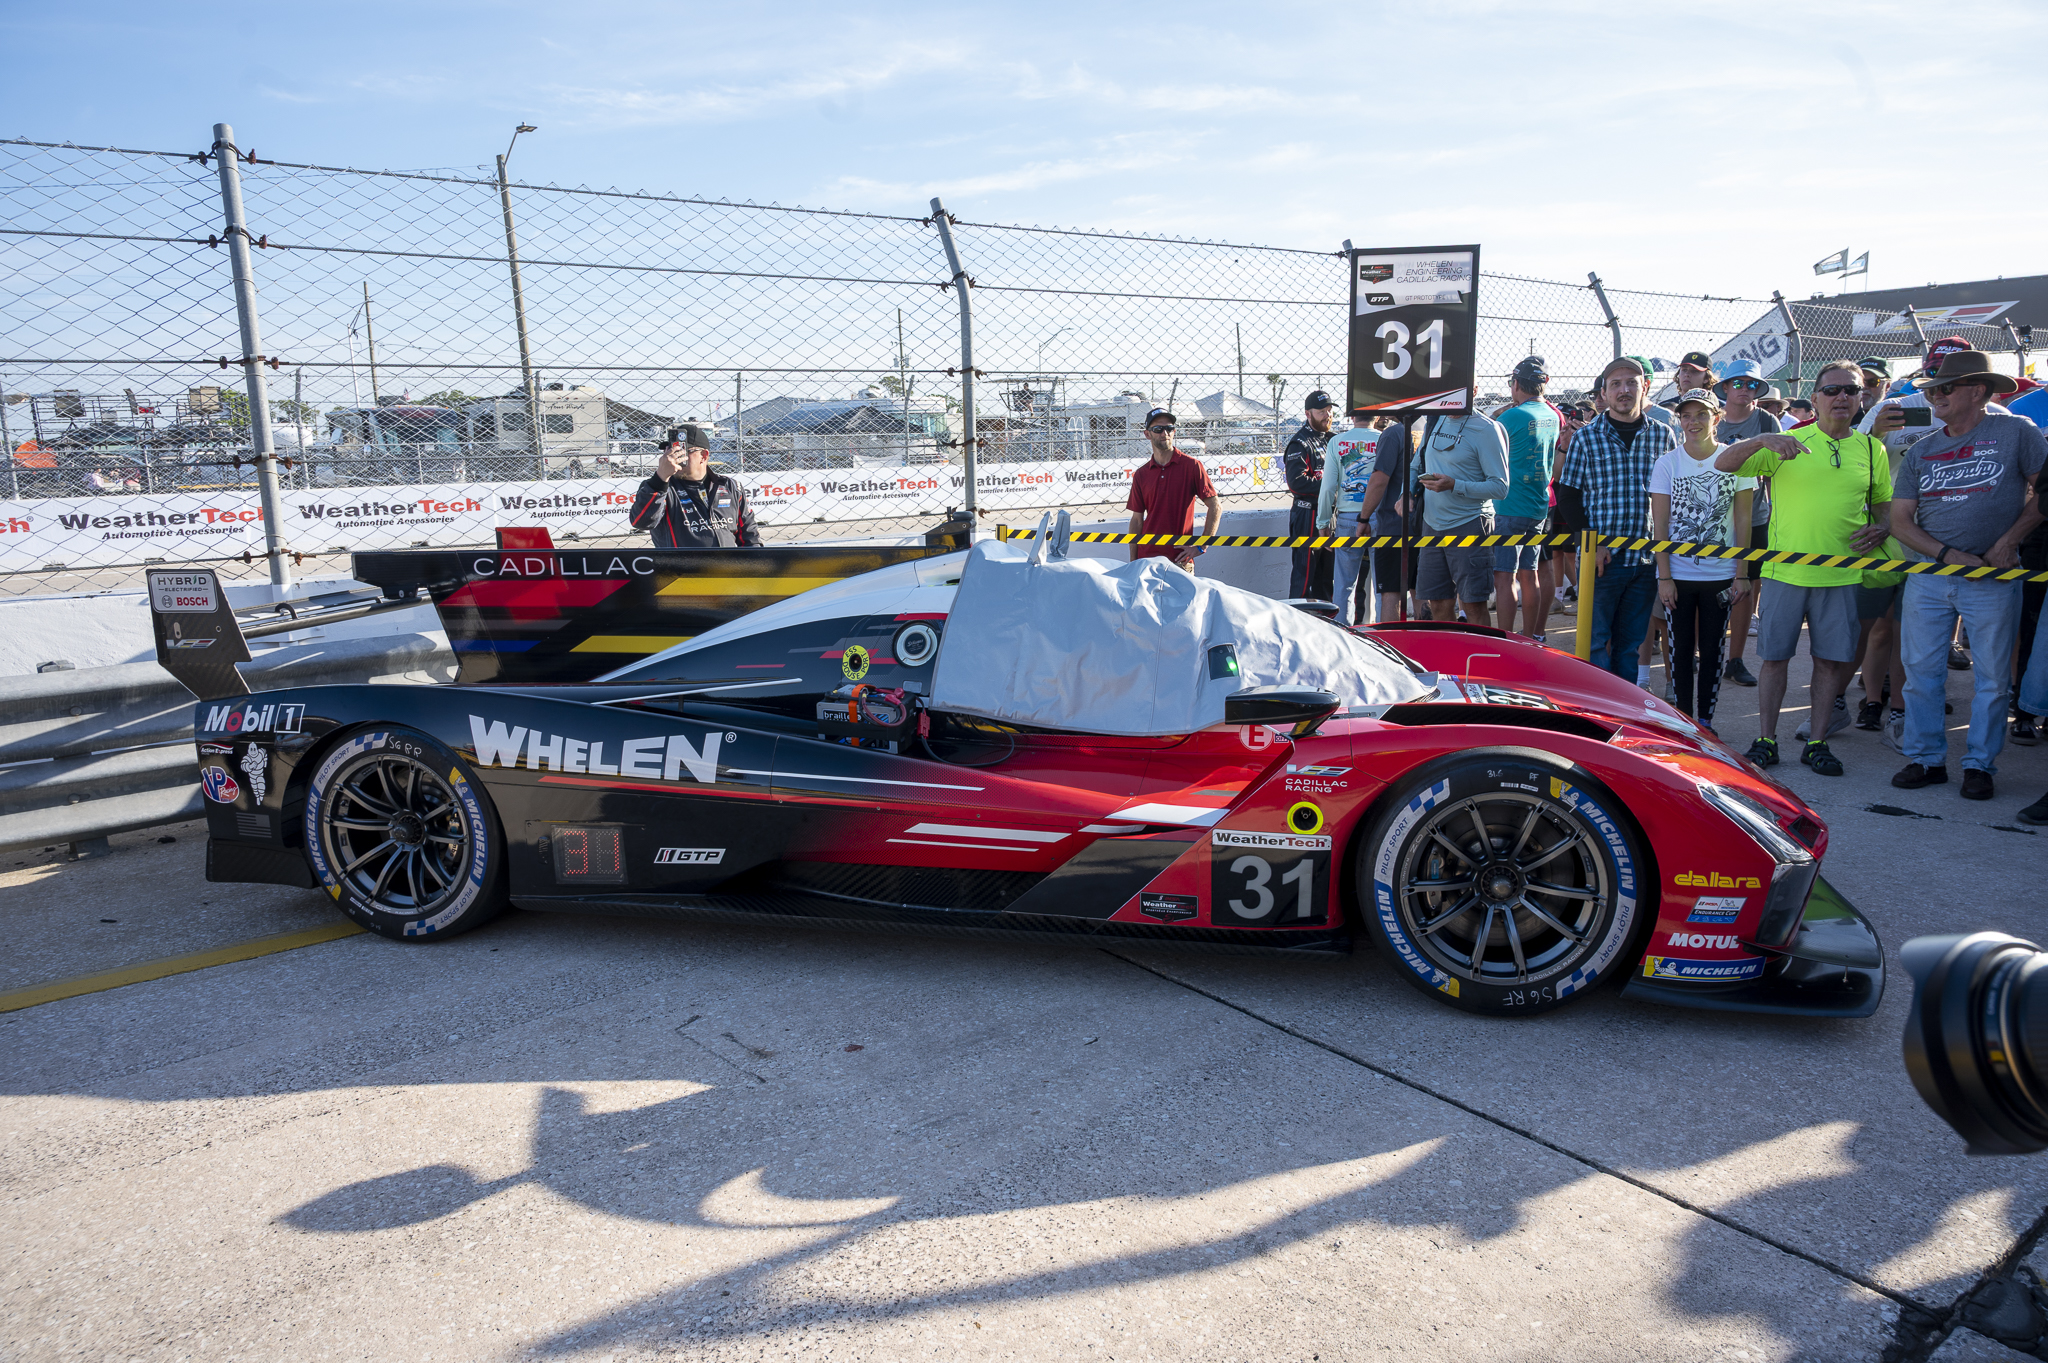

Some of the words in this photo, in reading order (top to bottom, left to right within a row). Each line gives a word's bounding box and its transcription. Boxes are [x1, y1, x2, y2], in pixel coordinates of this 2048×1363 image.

[1406, 267, 1463, 276] ENGINEERING
[1416, 260, 1454, 268] WHELEN
[1396, 275, 1438, 284] CADILLAC
[1440, 274, 1472, 282] RACING
[1372, 319, 1444, 380] 31
[1206, 465, 1247, 475] erTech
[951, 473, 1053, 487] WatherTech
[744, 483, 807, 497] erTech
[1956, 486, 1993, 494] SUPPLY
[500, 492, 636, 510] WeatherTec
[335, 519, 394, 528] Automotive
[397, 516, 455, 525] Accessories
[530, 510, 581, 518] Automotive
[102, 528, 173, 541] Automotive
[176, 525, 245, 536] Accessories
[473, 556, 655, 577] CADILLAC
[157, 575, 207, 585] HYBRID
[176, 597, 209, 606] BOSCH
[844, 646, 858, 658] ESS
[842, 661, 860, 680] DOUSE
[860, 652, 869, 674] PORT
[204, 705, 275, 732] Mobil
[285, 707, 295, 730] 1
[1248, 725, 1265, 747] E
[318, 764, 331, 784] PILOT
[331, 747, 350, 766] SPORT
[201, 766, 227, 802] VP
[1285, 778, 1348, 787] CADILLAC
[1285, 785, 1332, 793] RACING
[307, 792, 326, 871] MICHELIN
[465, 798, 485, 879] MICHELIN
[1216, 832, 1326, 848] WeatherTech
[1381, 849, 1392, 875] PILOT
[1389, 817, 1408, 847] SPORT
[1580, 801, 1634, 890] MICHELIN
[676, 851, 721, 861] GTP
[1228, 855, 1314, 919] 31
[1674, 870, 1761, 888] dallara
[460, 887, 473, 907] PILOT
[440, 905, 459, 923] SPORT
[1617, 905, 1630, 934] PILOT
[1378, 890, 1431, 974] MICHELIN
[1667, 932, 1740, 949] MOTUL
[1600, 933, 1620, 963] SPORT
[1528, 965, 1562, 982] CADILLAC
[1562, 948, 1584, 967] RACING
[1681, 965, 1757, 976] MICHELIN
[1502, 990, 1526, 1006] RF
